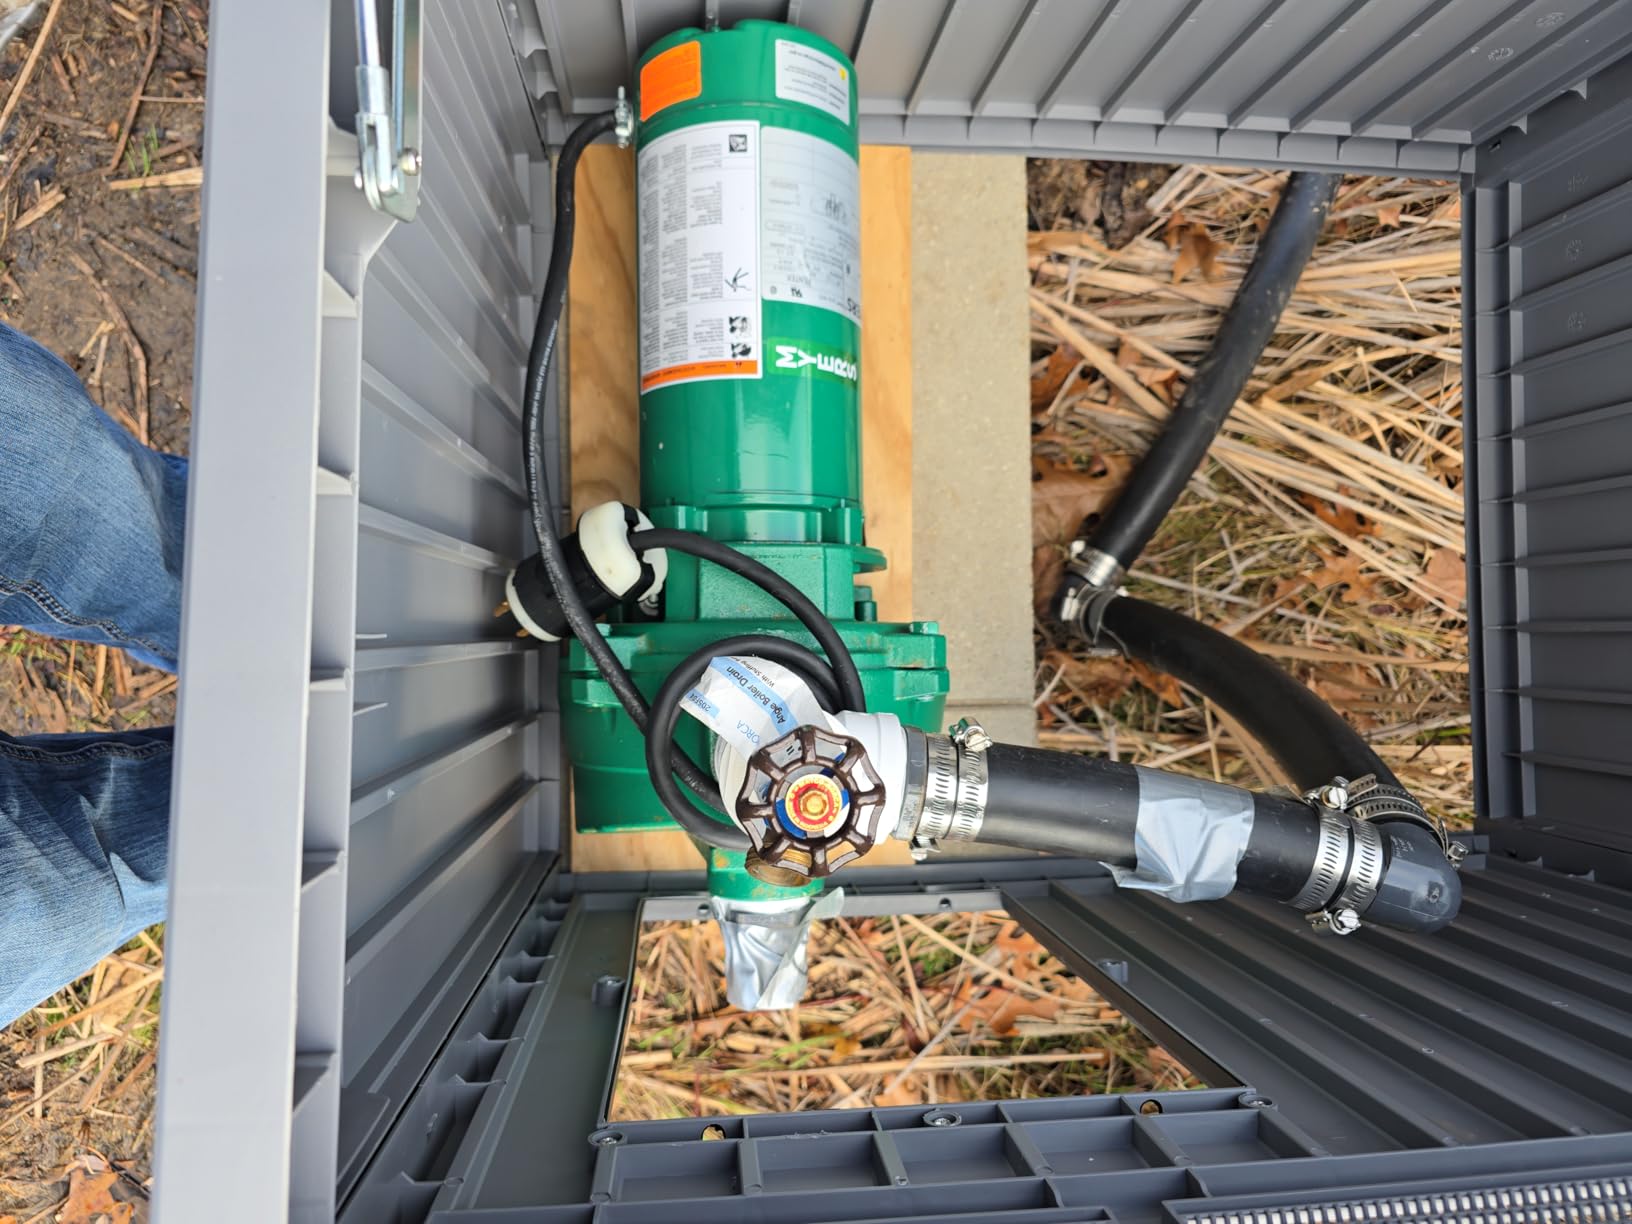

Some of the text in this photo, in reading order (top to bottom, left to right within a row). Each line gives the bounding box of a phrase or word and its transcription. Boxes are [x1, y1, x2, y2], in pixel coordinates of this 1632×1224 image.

[775, 345, 858, 382] MYERS
[726, 666, 786, 725] Angle Boiler Drain
